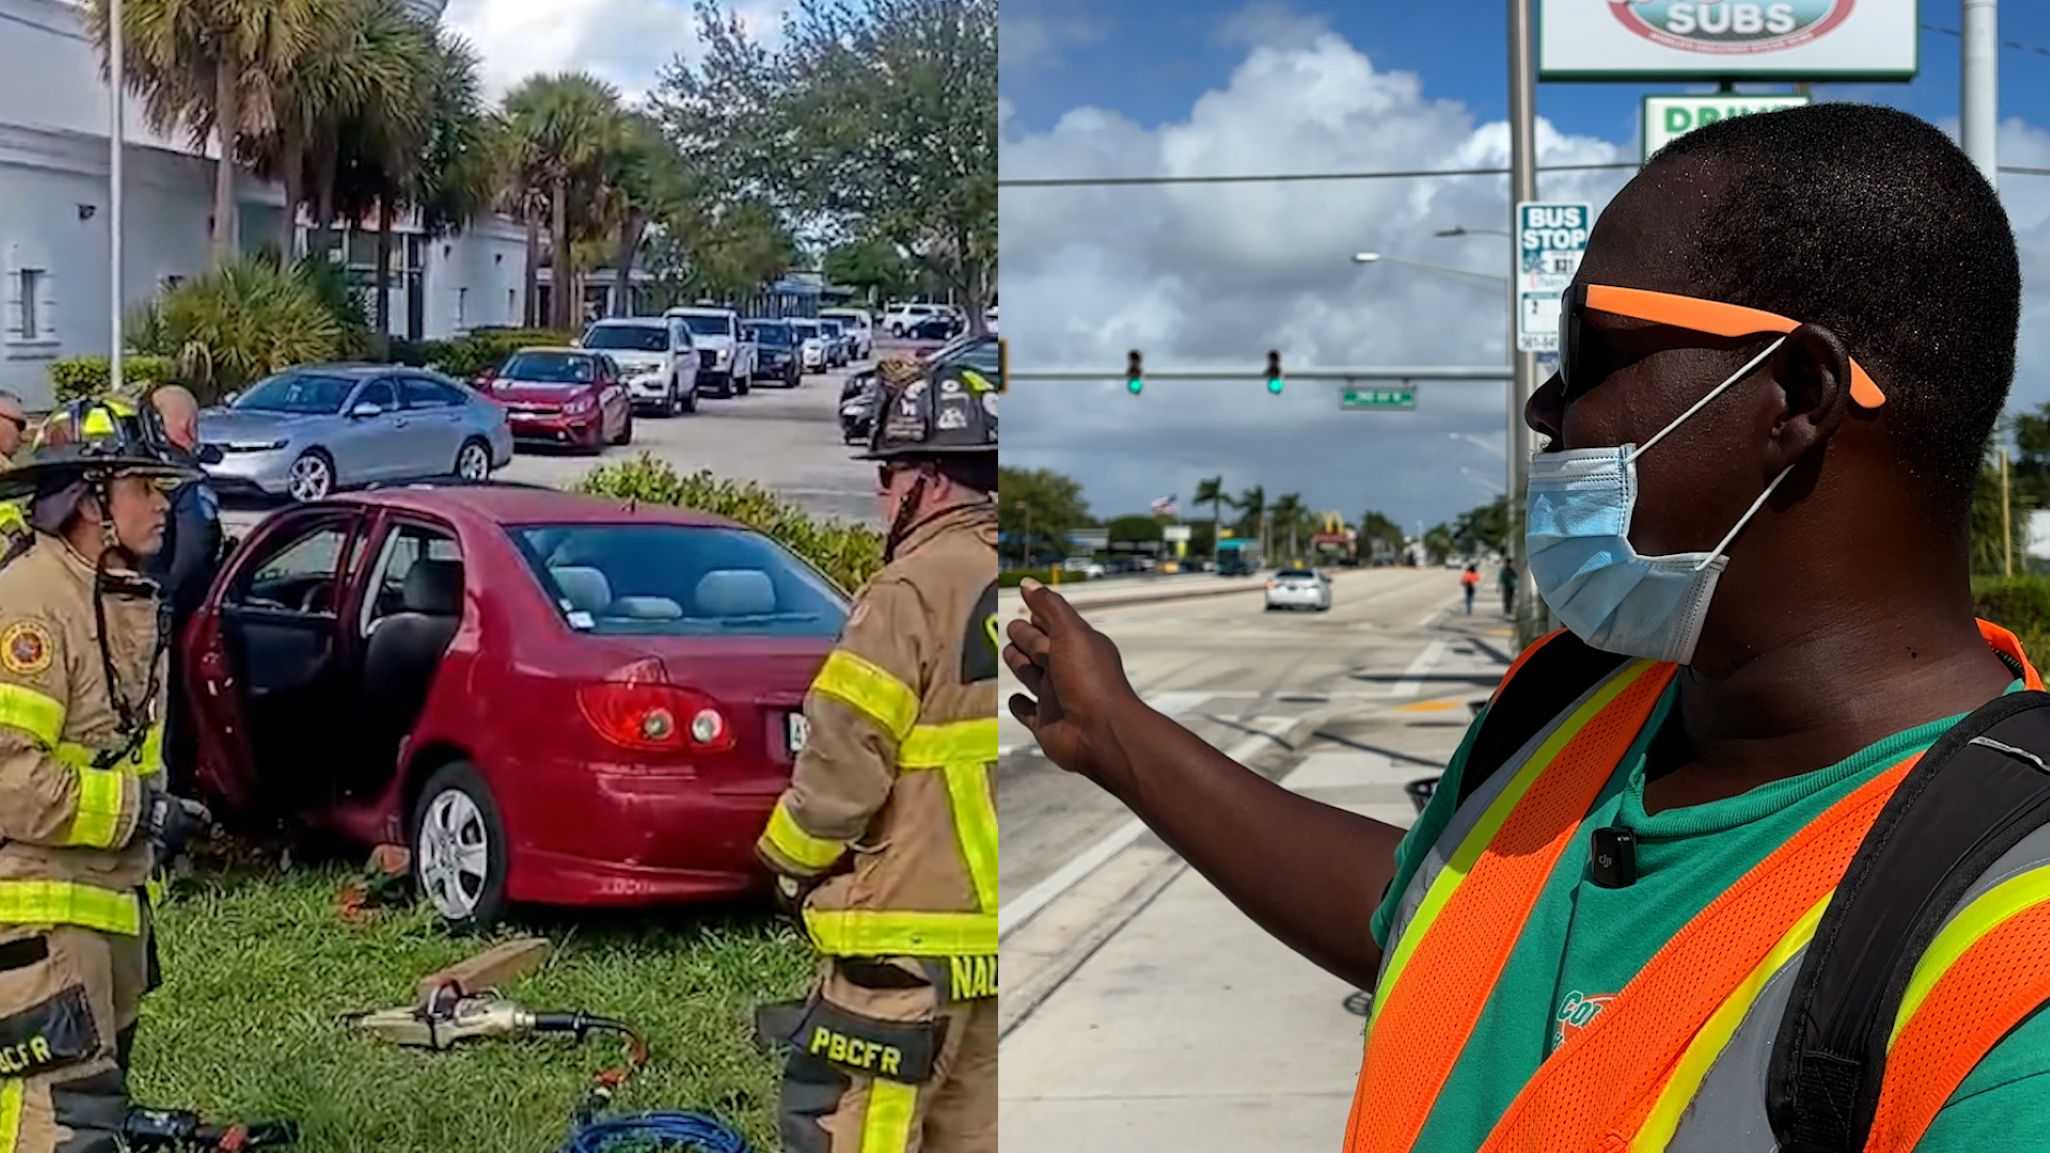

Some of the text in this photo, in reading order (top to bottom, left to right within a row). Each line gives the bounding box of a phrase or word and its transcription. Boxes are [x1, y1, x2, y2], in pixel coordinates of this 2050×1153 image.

[1666, 2, 1796, 35] SUBS
[1527, 207, 1582, 228] BUS
[1522, 228, 1587, 250] STOP
[810, 1026, 902, 1074] PBCFR
